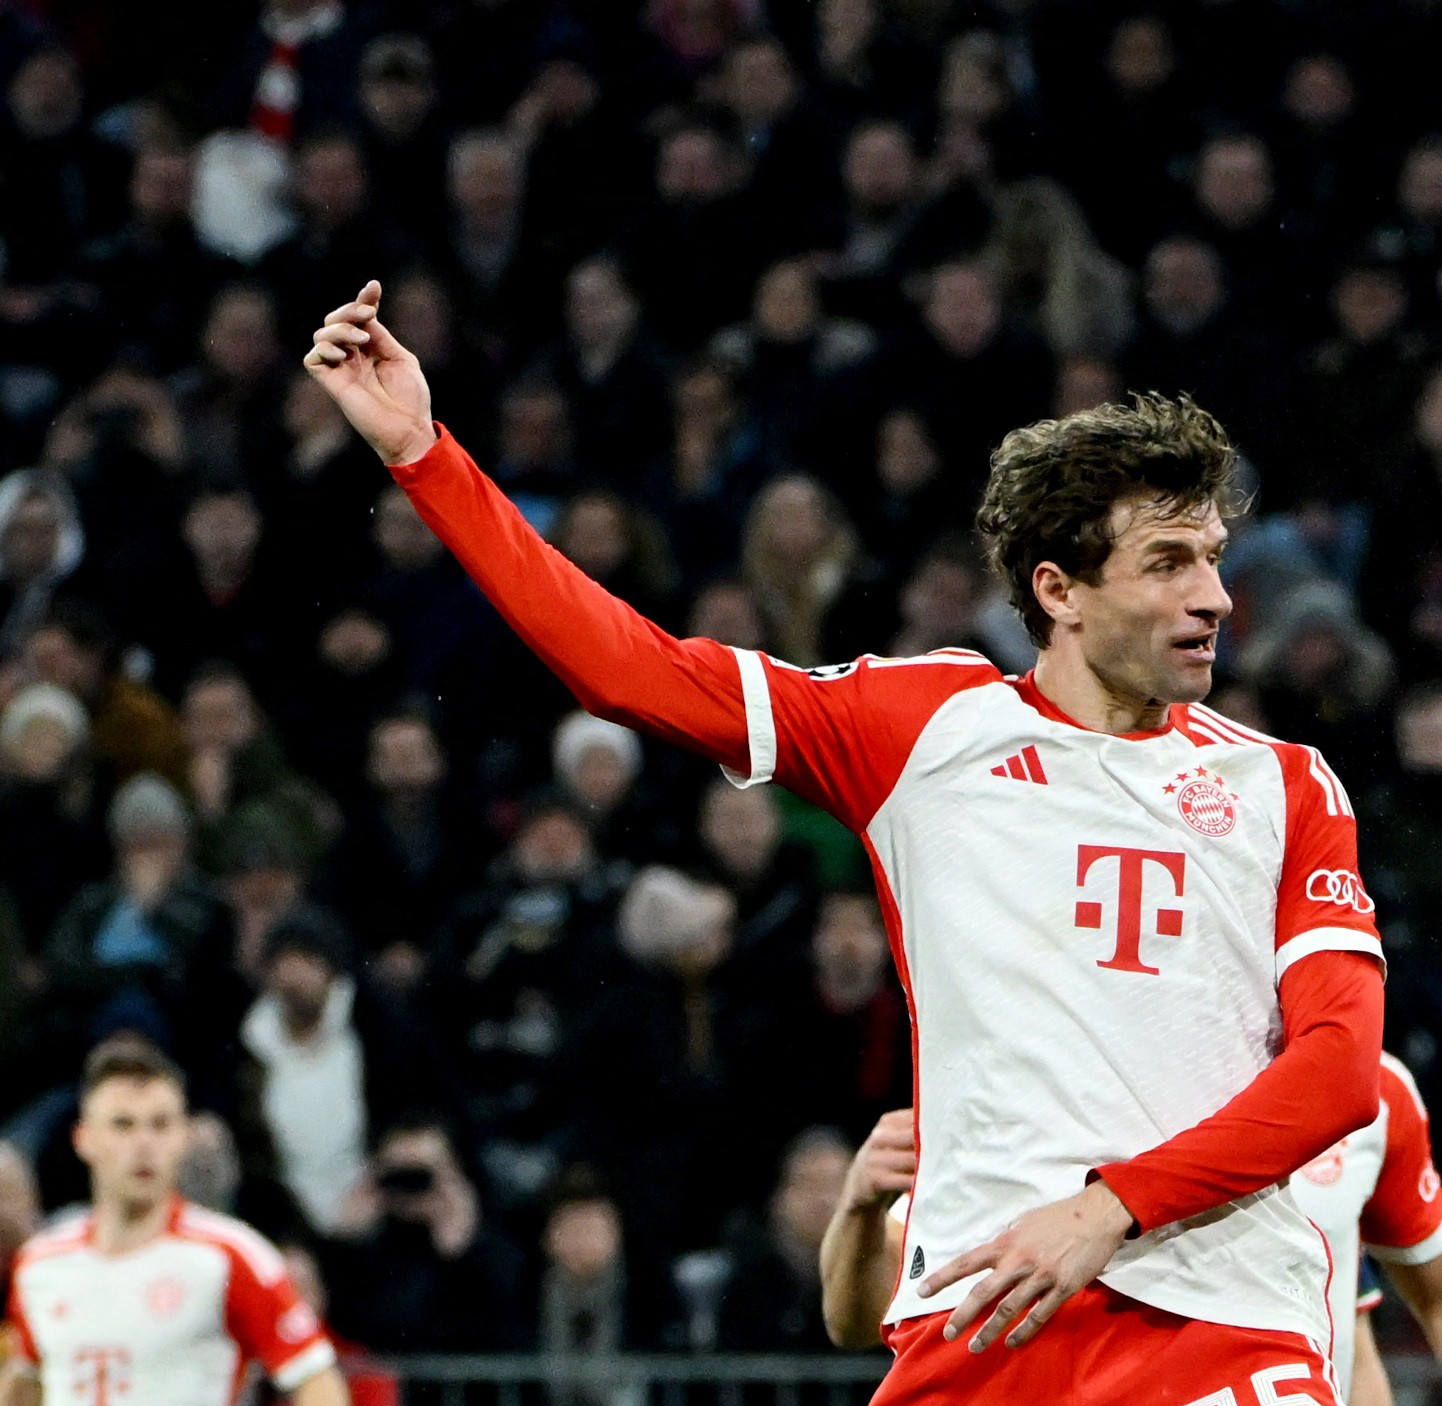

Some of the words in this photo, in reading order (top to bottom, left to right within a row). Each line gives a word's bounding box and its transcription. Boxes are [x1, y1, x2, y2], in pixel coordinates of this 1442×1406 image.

[1182, 789, 1195, 804] FC
[1192, 784, 1231, 808] BAYERN
[1075, 844, 1185, 976] T
